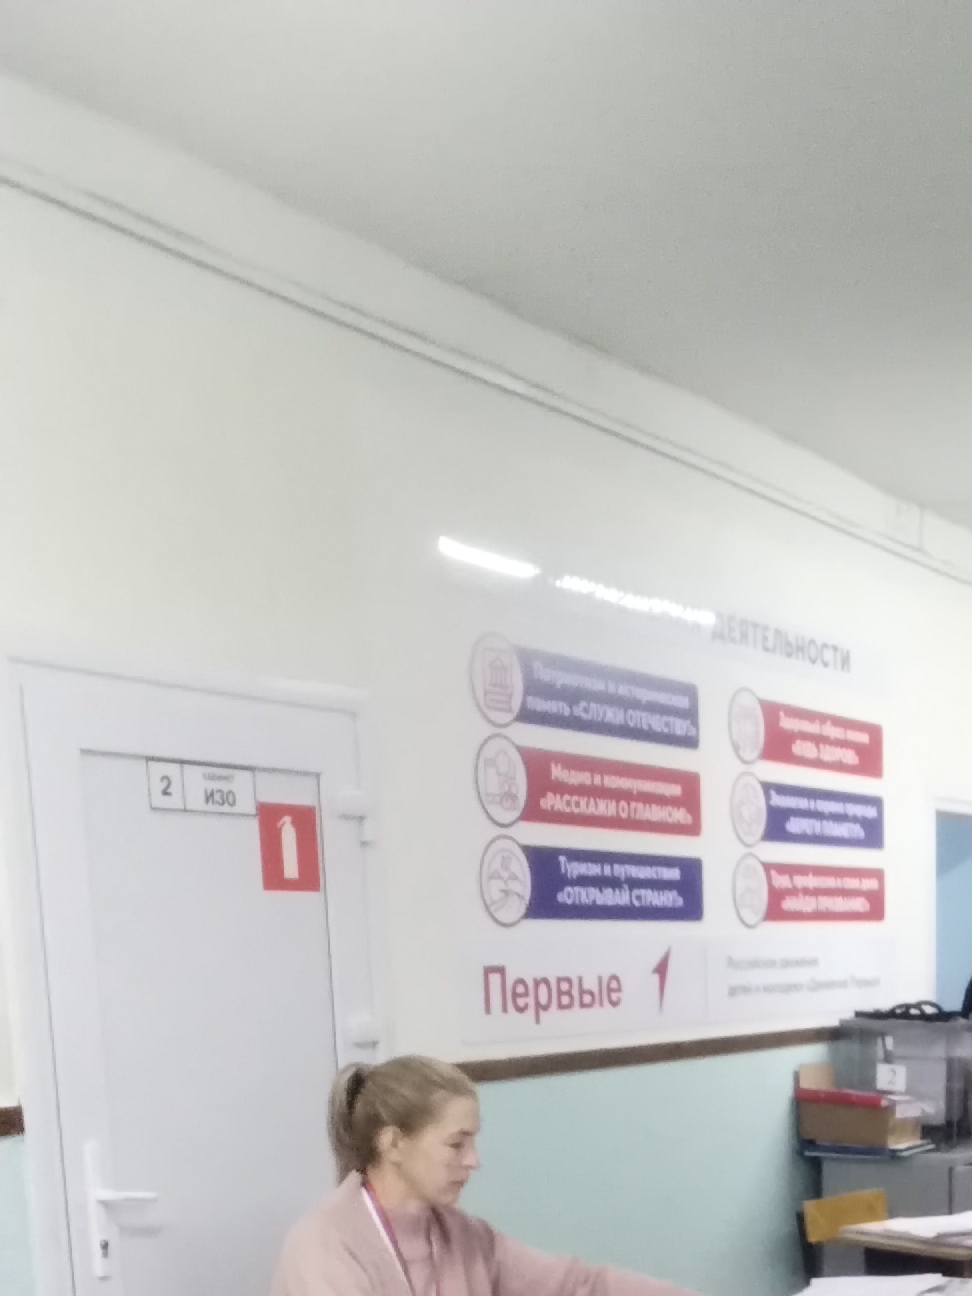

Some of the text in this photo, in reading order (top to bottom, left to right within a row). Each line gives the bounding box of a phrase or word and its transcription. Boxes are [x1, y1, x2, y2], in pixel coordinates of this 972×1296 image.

[711, 611, 851, 673] ДЕЯТЕЛЬНОСТИ
[160, 775, 172, 796] 2
[551, 762, 592, 786] Медиа
[204, 788, 236, 807] ИЗО
[618, 800, 628, 818] О
[558, 855, 602, 879] Туризм
[483, 964, 623, 1025] Первые
